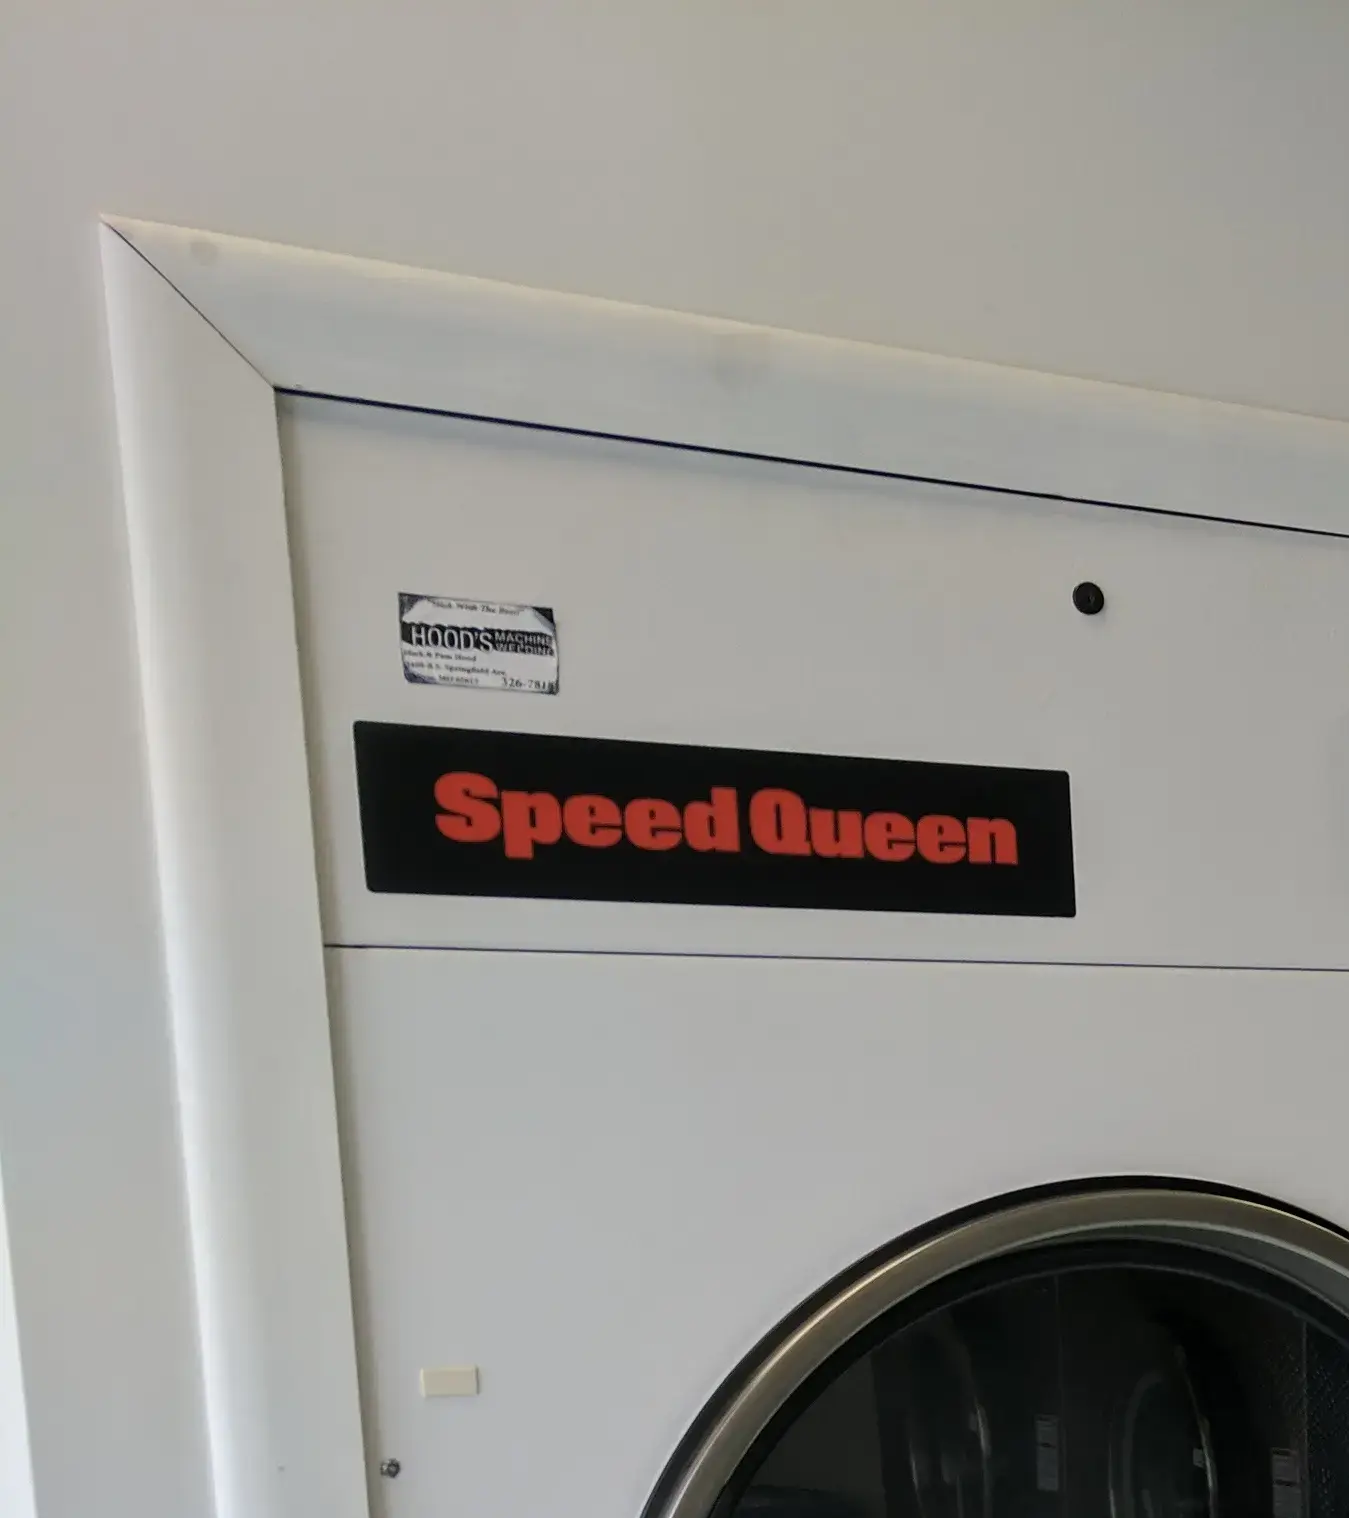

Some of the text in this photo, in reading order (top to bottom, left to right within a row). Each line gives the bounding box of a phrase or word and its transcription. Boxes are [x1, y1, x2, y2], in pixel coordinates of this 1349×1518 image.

[411, 625, 493, 652] HOOD'S
[434, 770, 1019, 866] Speed Queen
